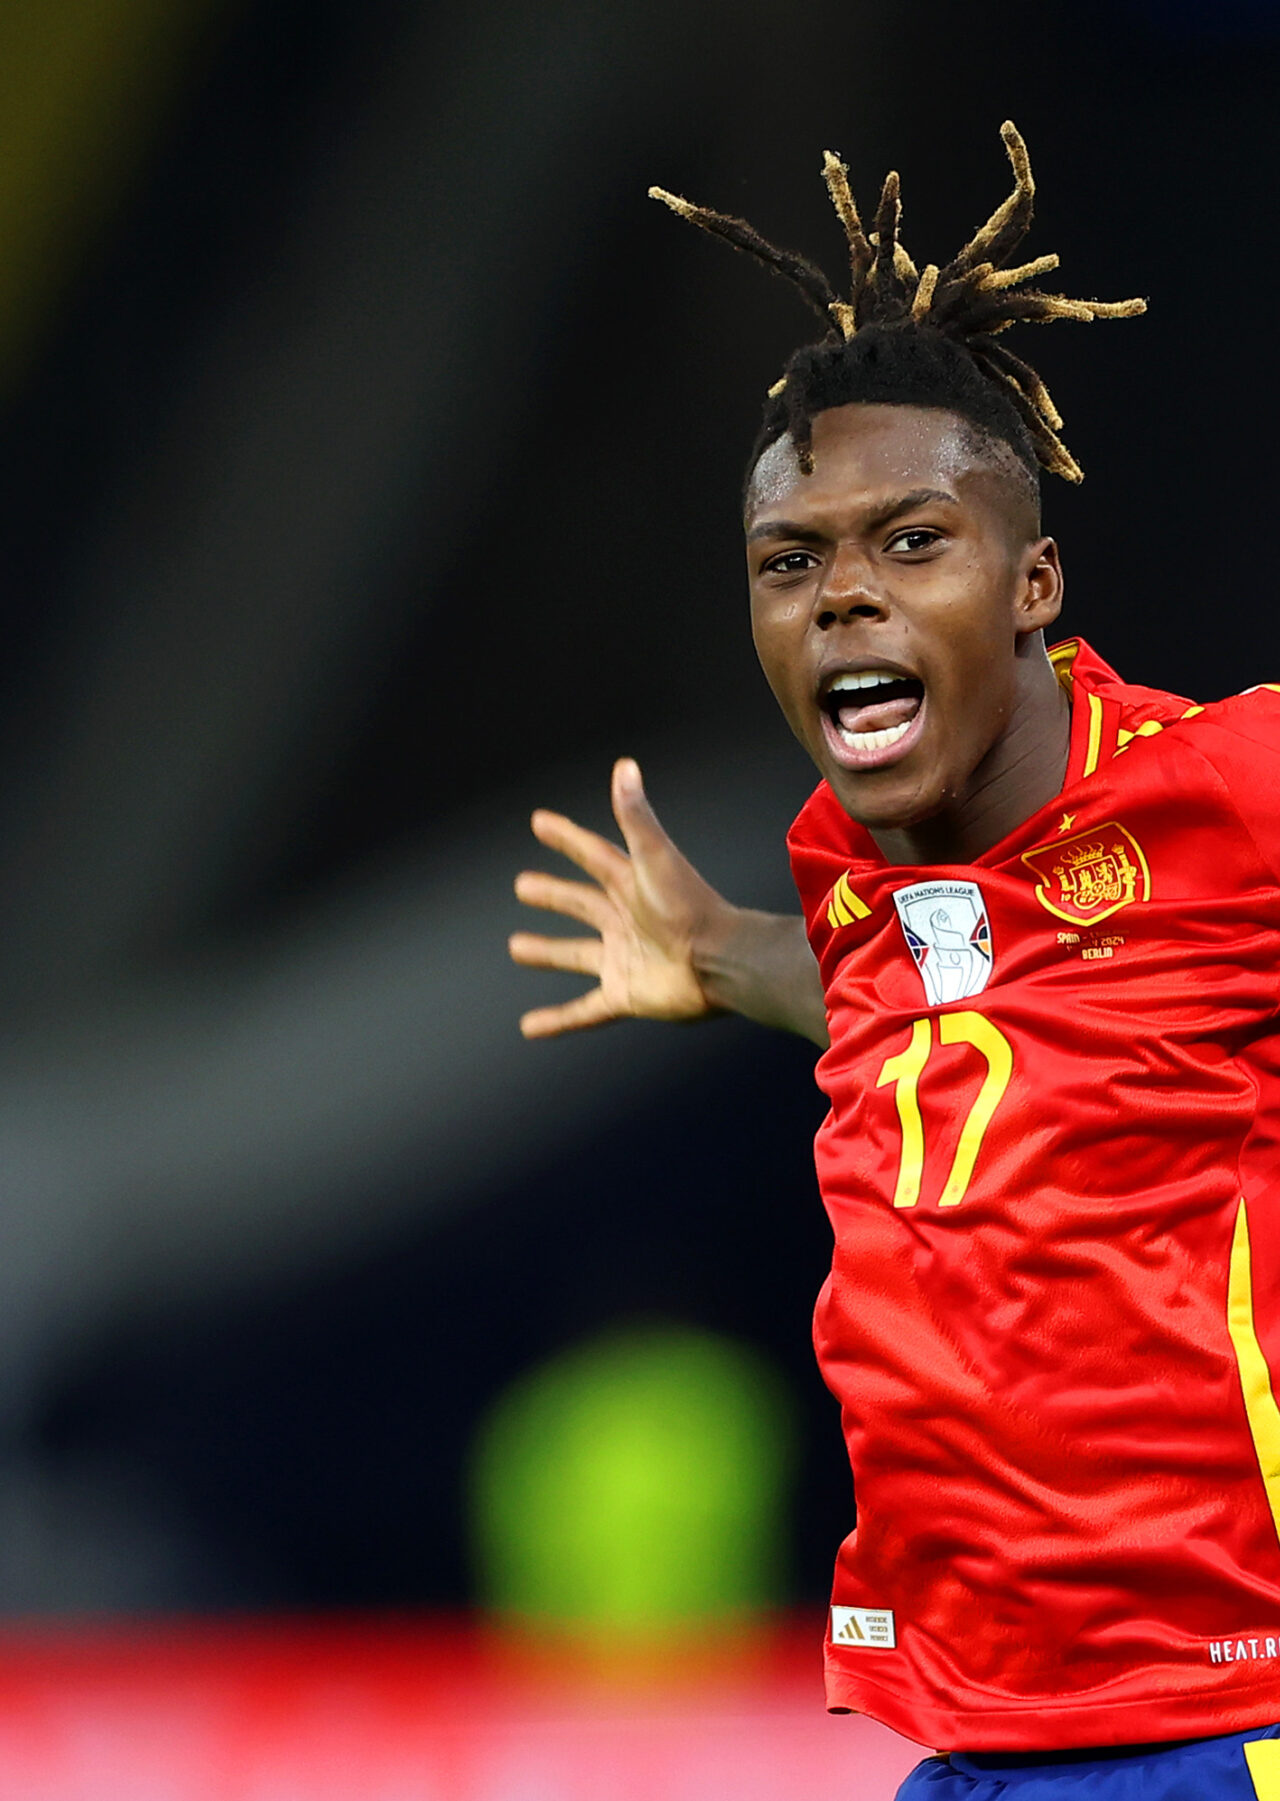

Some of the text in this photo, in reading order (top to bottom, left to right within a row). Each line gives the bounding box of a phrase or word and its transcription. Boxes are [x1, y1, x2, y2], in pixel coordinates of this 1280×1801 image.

[897, 885, 975, 904] UEFA NATIONS LEAGUE
[1056, 931, 1080, 944] SPAIN
[1101, 936, 1125, 946] 2024
[1082, 947, 1113, 960] BERLIN
[875, 1010, 1014, 1208] 17
